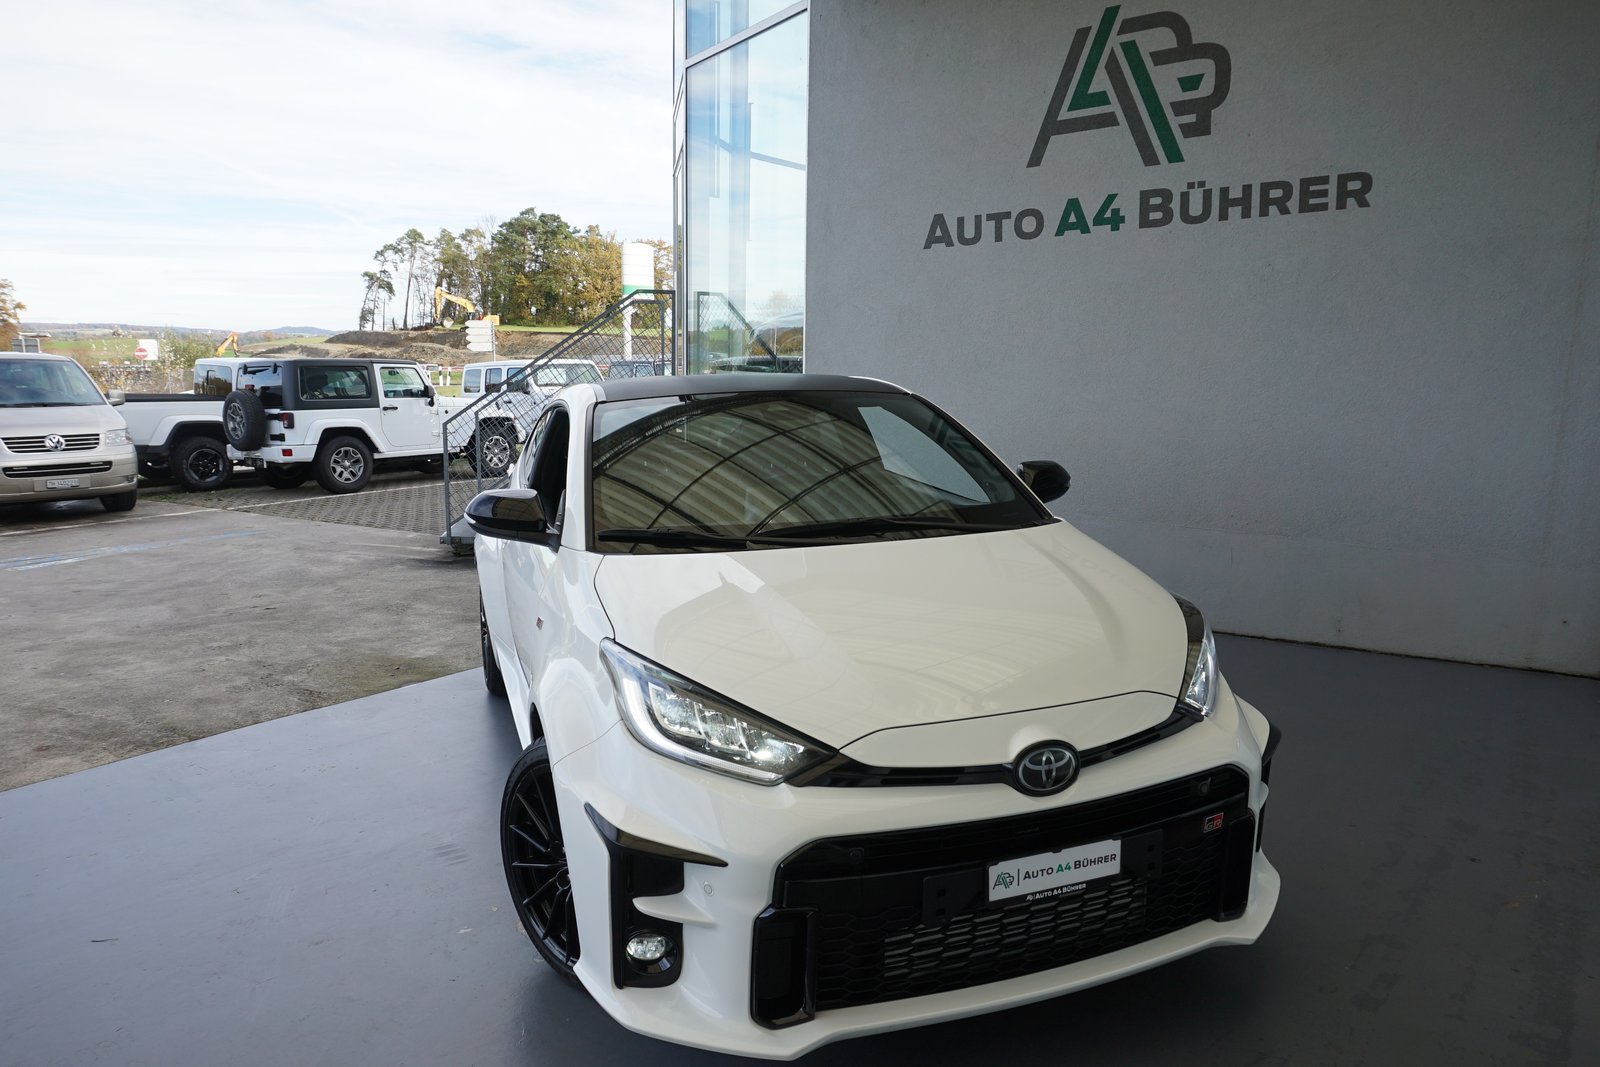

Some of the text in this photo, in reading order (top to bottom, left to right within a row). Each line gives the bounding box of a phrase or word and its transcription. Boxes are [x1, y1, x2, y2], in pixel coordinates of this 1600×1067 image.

[923, 170, 1374, 250] AUTO A4 BÜHRER
[1023, 866, 1054, 881] AUTO
[1055, 862, 1072, 874] A4
[1073, 853, 1117, 870] BÜHRER
[1035, 890, 1053, 900] AUTO
[1052, 888, 1062, 896] A4
